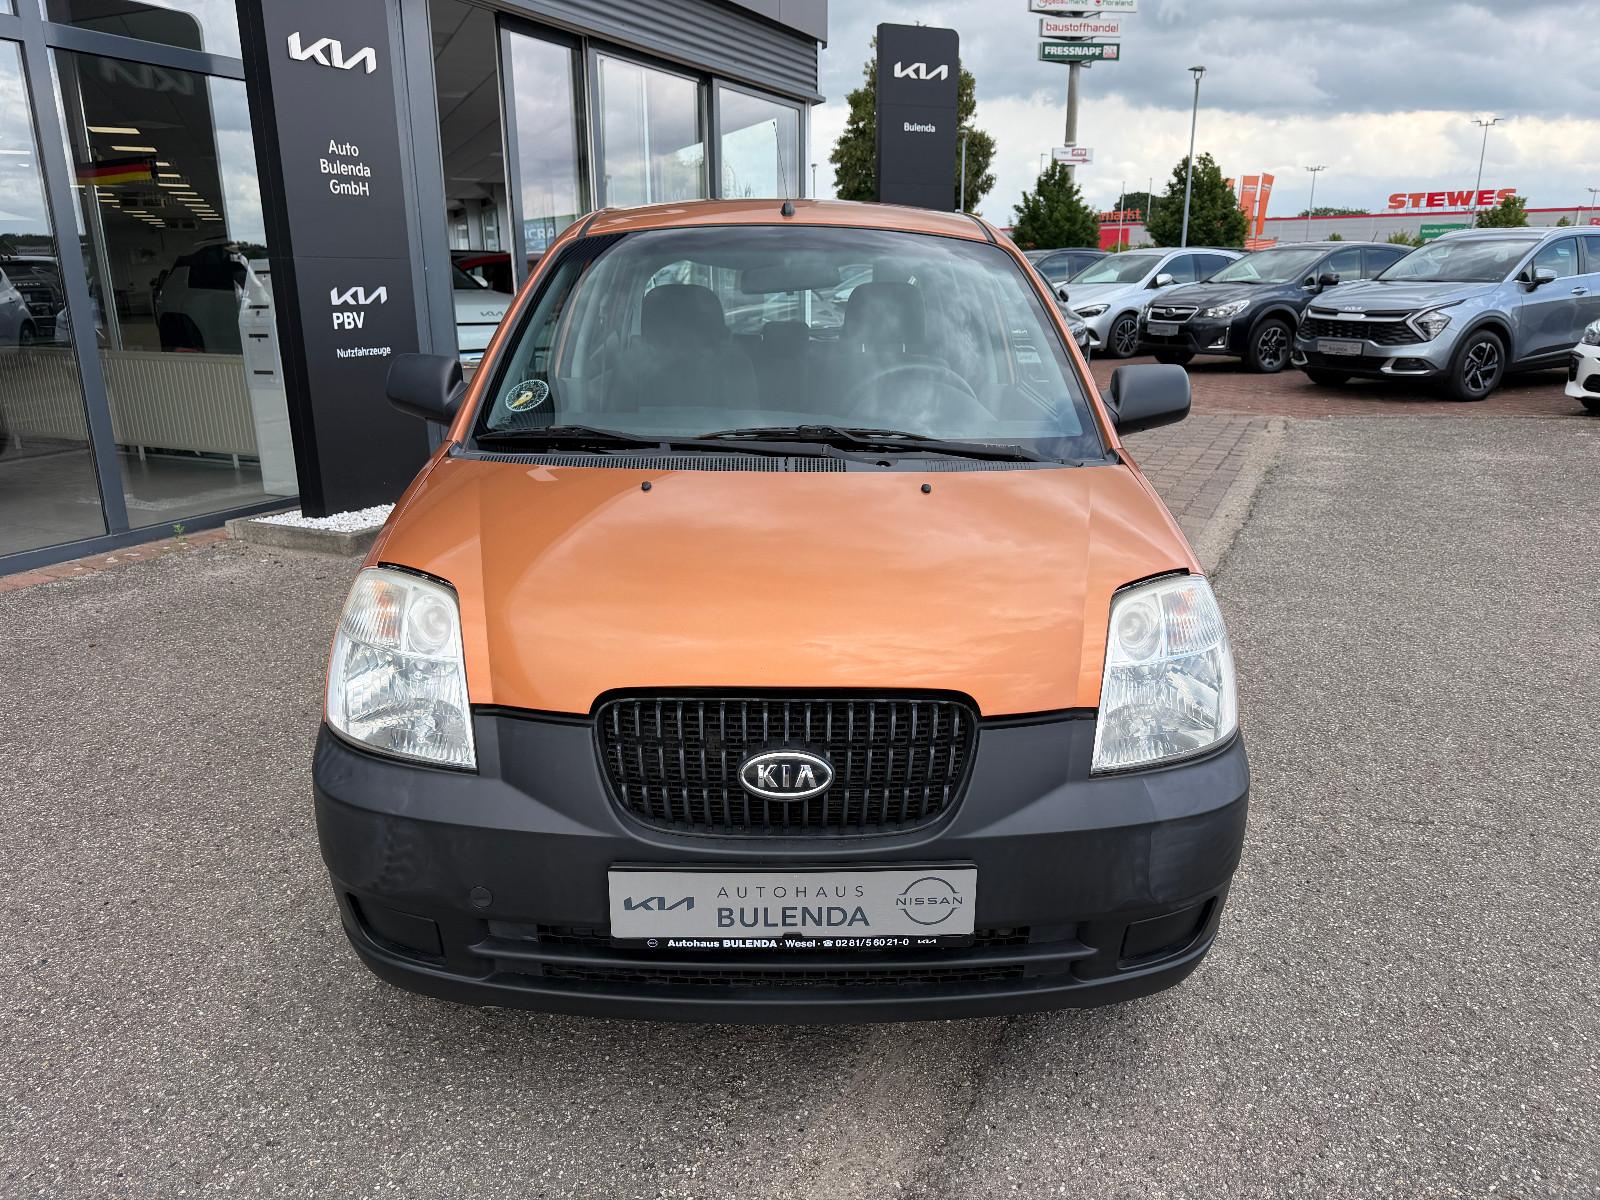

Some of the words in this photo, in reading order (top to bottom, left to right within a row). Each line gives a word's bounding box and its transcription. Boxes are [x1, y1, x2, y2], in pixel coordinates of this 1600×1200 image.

[1045, 22, 1119, 33] baustoffhandel
[1044, 45, 1102, 56] FRESSNAPF
[903, 122, 936, 133] Bulenda
[328, 140, 359, 157] Auto
[319, 158, 371, 178] Bulenda
[329, 180, 370, 197] GmbH
[1388, 188, 1517, 209] STEWES
[332, 311, 365, 330] PBV
[336, 345, 391, 360] Nutzfahrzeuge
[757, 764, 817, 789] KIA
[717, 885, 865, 899] AUTOHAUS
[895, 895, 963, 906] NISSAN
[717, 907, 870, 928] BULENDA
[667, 938, 720, 948] Autohaus
[722, 938, 777, 948] BULENDA
[785, 938, 816, 948] Wesel
